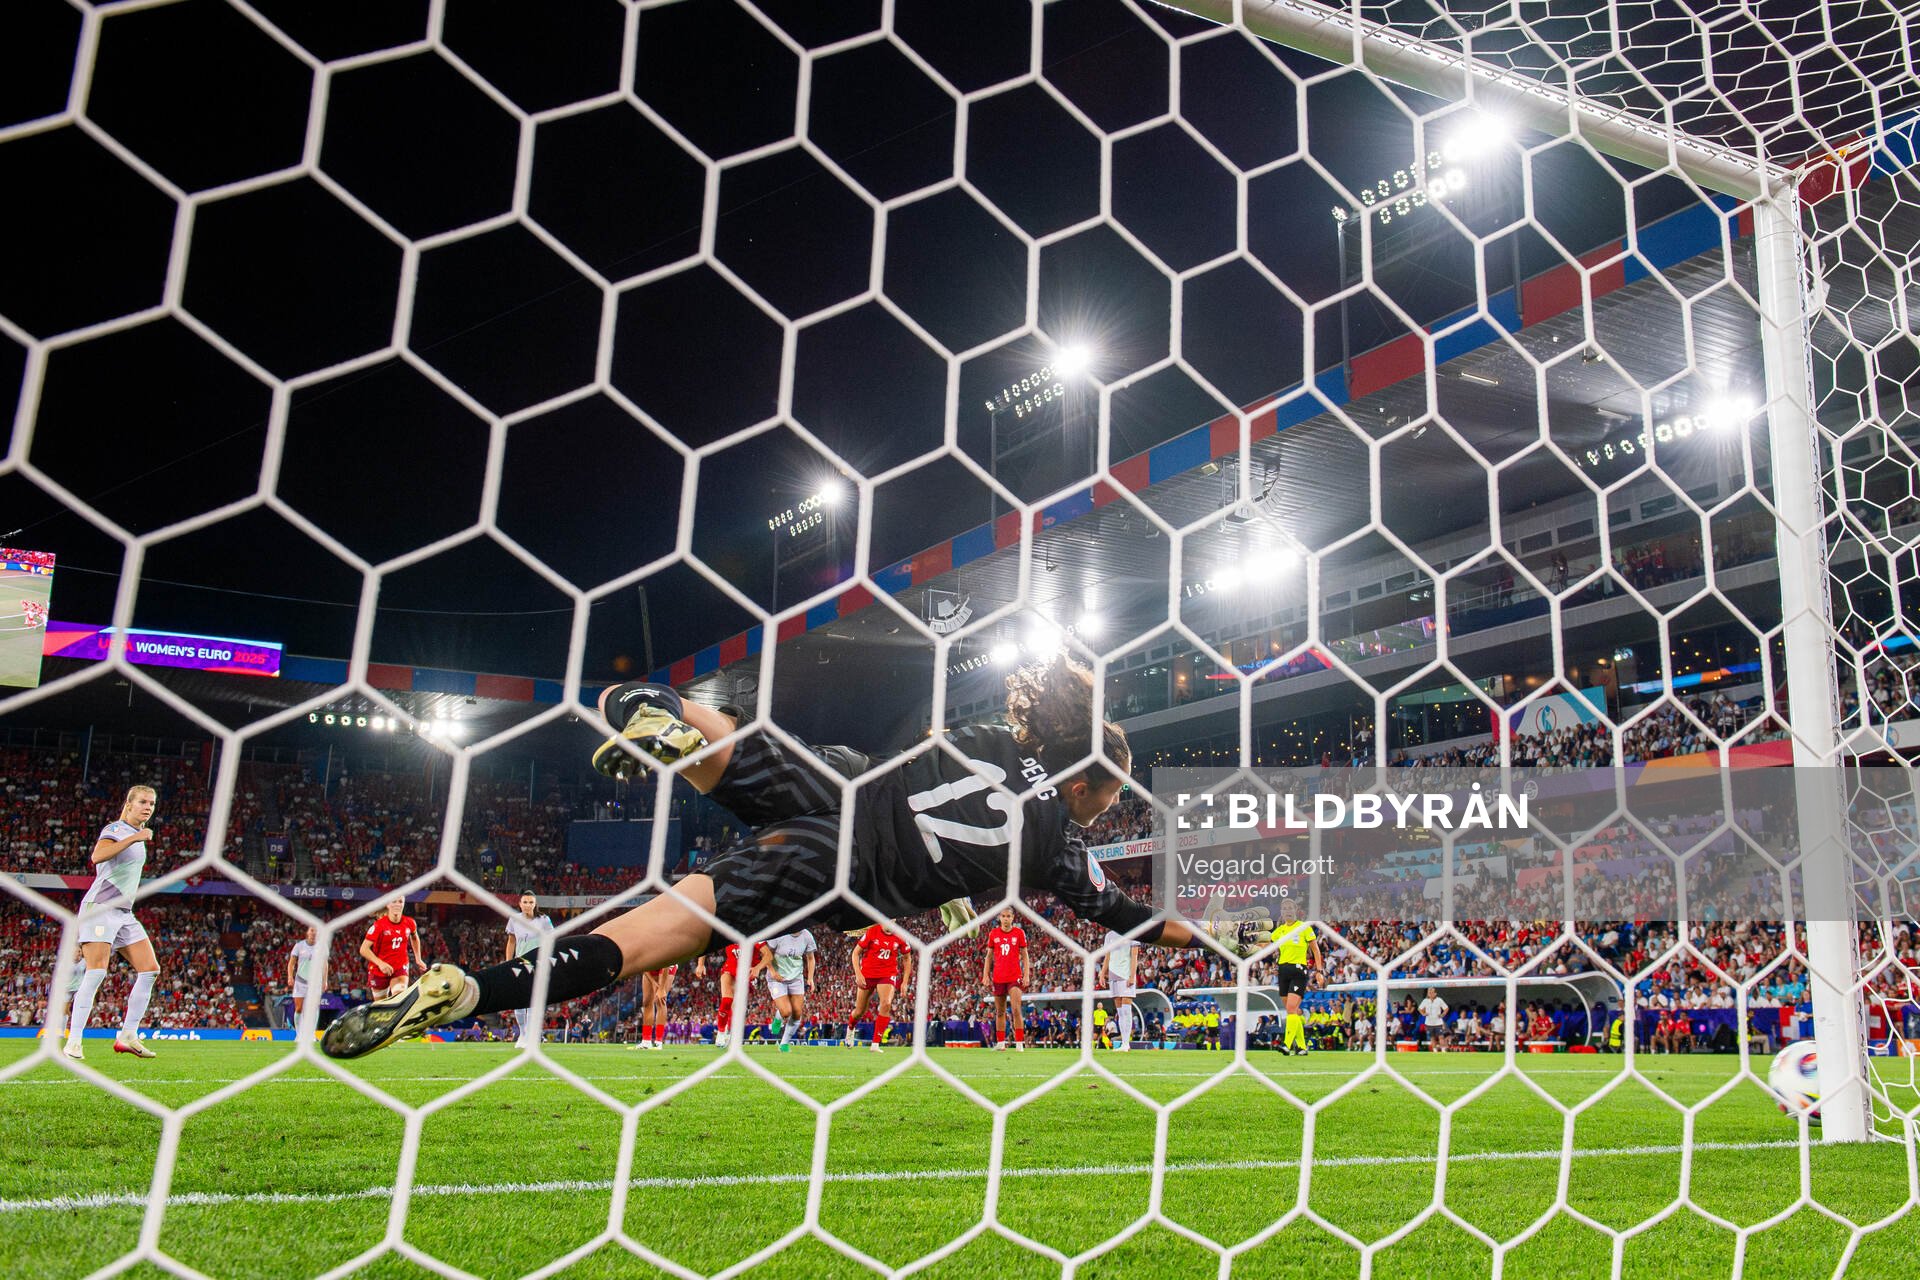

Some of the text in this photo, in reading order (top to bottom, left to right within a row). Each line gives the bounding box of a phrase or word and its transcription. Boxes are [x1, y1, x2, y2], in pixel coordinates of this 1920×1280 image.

[98, 638, 134, 652] UA
[136, 641, 195, 658] WOMEN'S
[197, 648, 232, 661] EURO
[1106, 845, 1125, 858] EURO
[1178, 835, 1199, 848] 2025
[293, 887, 328, 897] BASEL
[877, 948, 891, 960] 20
[1000, 943, 1010, 956] 19
